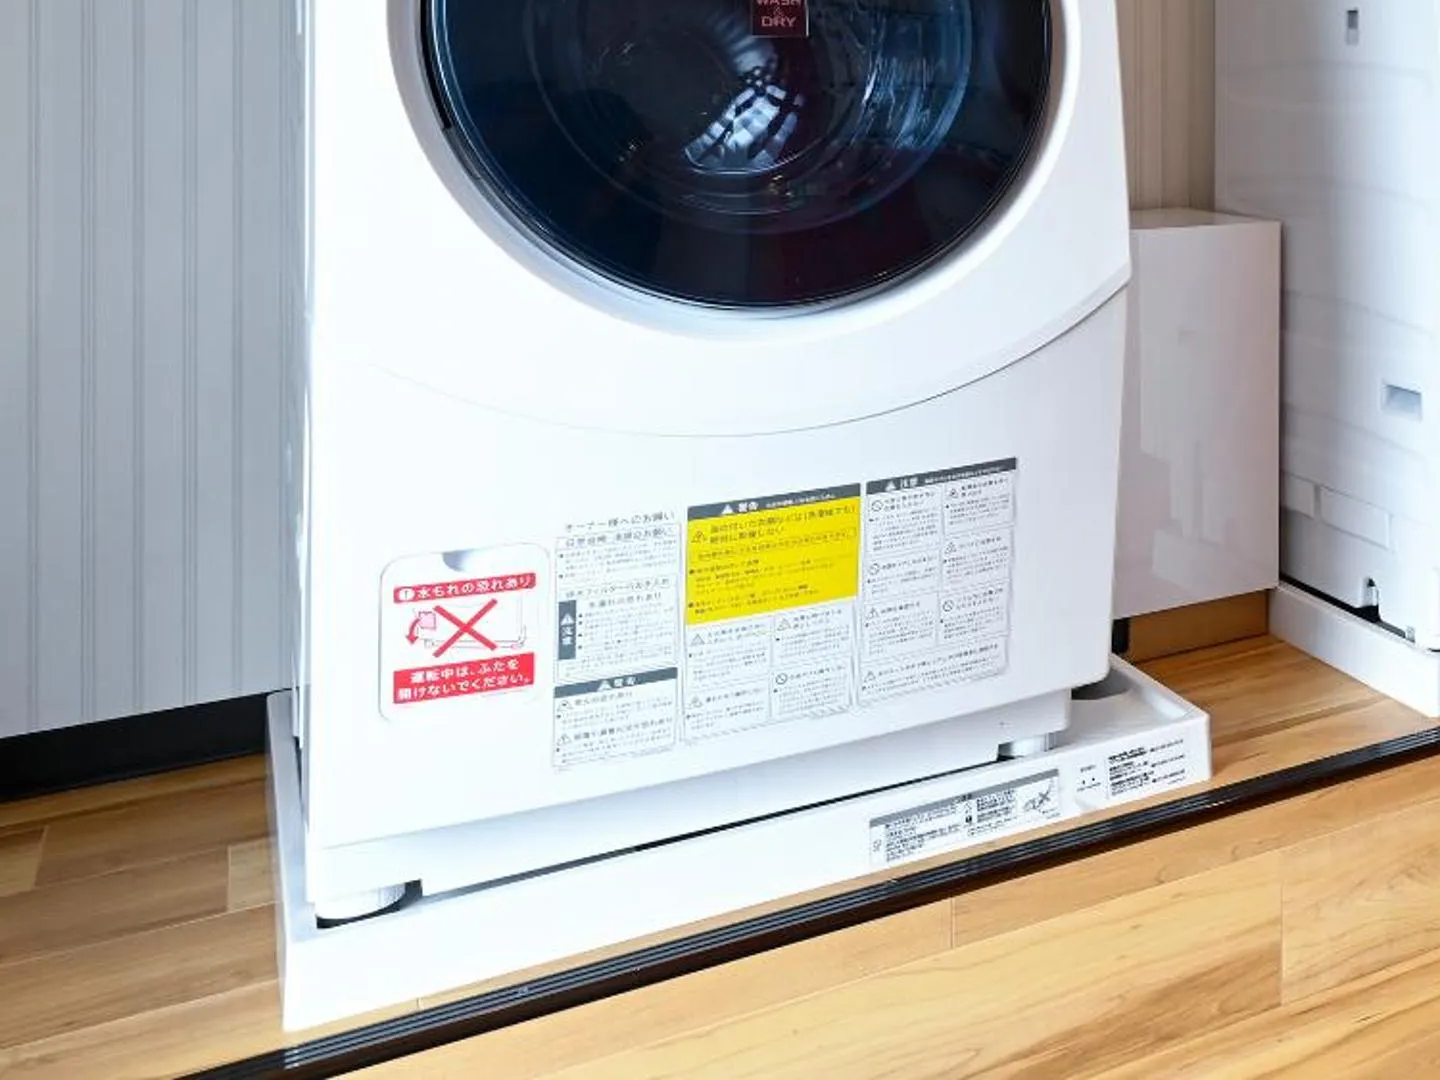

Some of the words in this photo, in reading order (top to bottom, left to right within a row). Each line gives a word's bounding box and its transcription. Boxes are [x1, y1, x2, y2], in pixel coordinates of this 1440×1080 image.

[761, 16, 797, 27] DRY
[410, 658, 519, 684] 運転中は、ふたを
[397, 675, 530, 700] 開けないでください。
